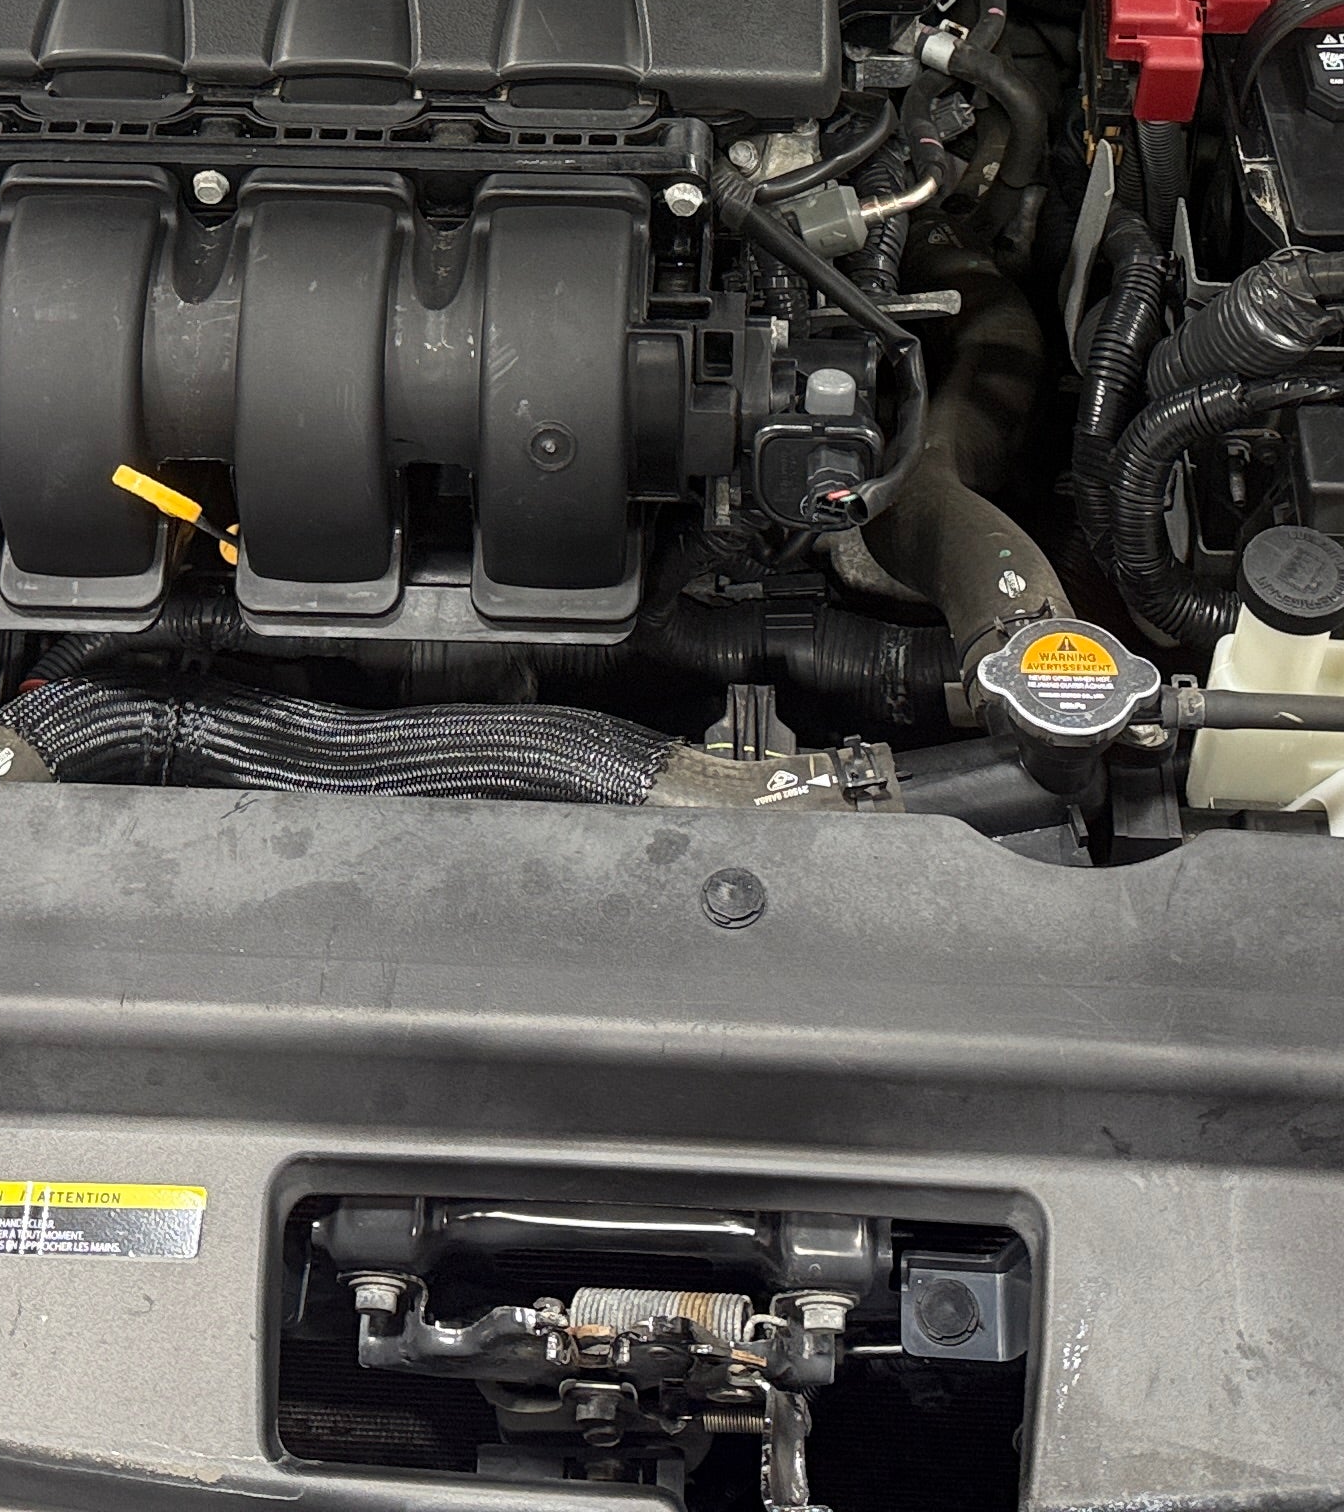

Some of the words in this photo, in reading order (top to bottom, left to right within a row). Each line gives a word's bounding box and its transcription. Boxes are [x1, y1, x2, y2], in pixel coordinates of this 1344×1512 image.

[1039, 652, 1097, 662] WARNING
[1027, 662, 1112, 672] AVERTISSEMENT
[37, 1191, 121, 1203] ATTENTION
[73, 1242, 89, 1252] LES
